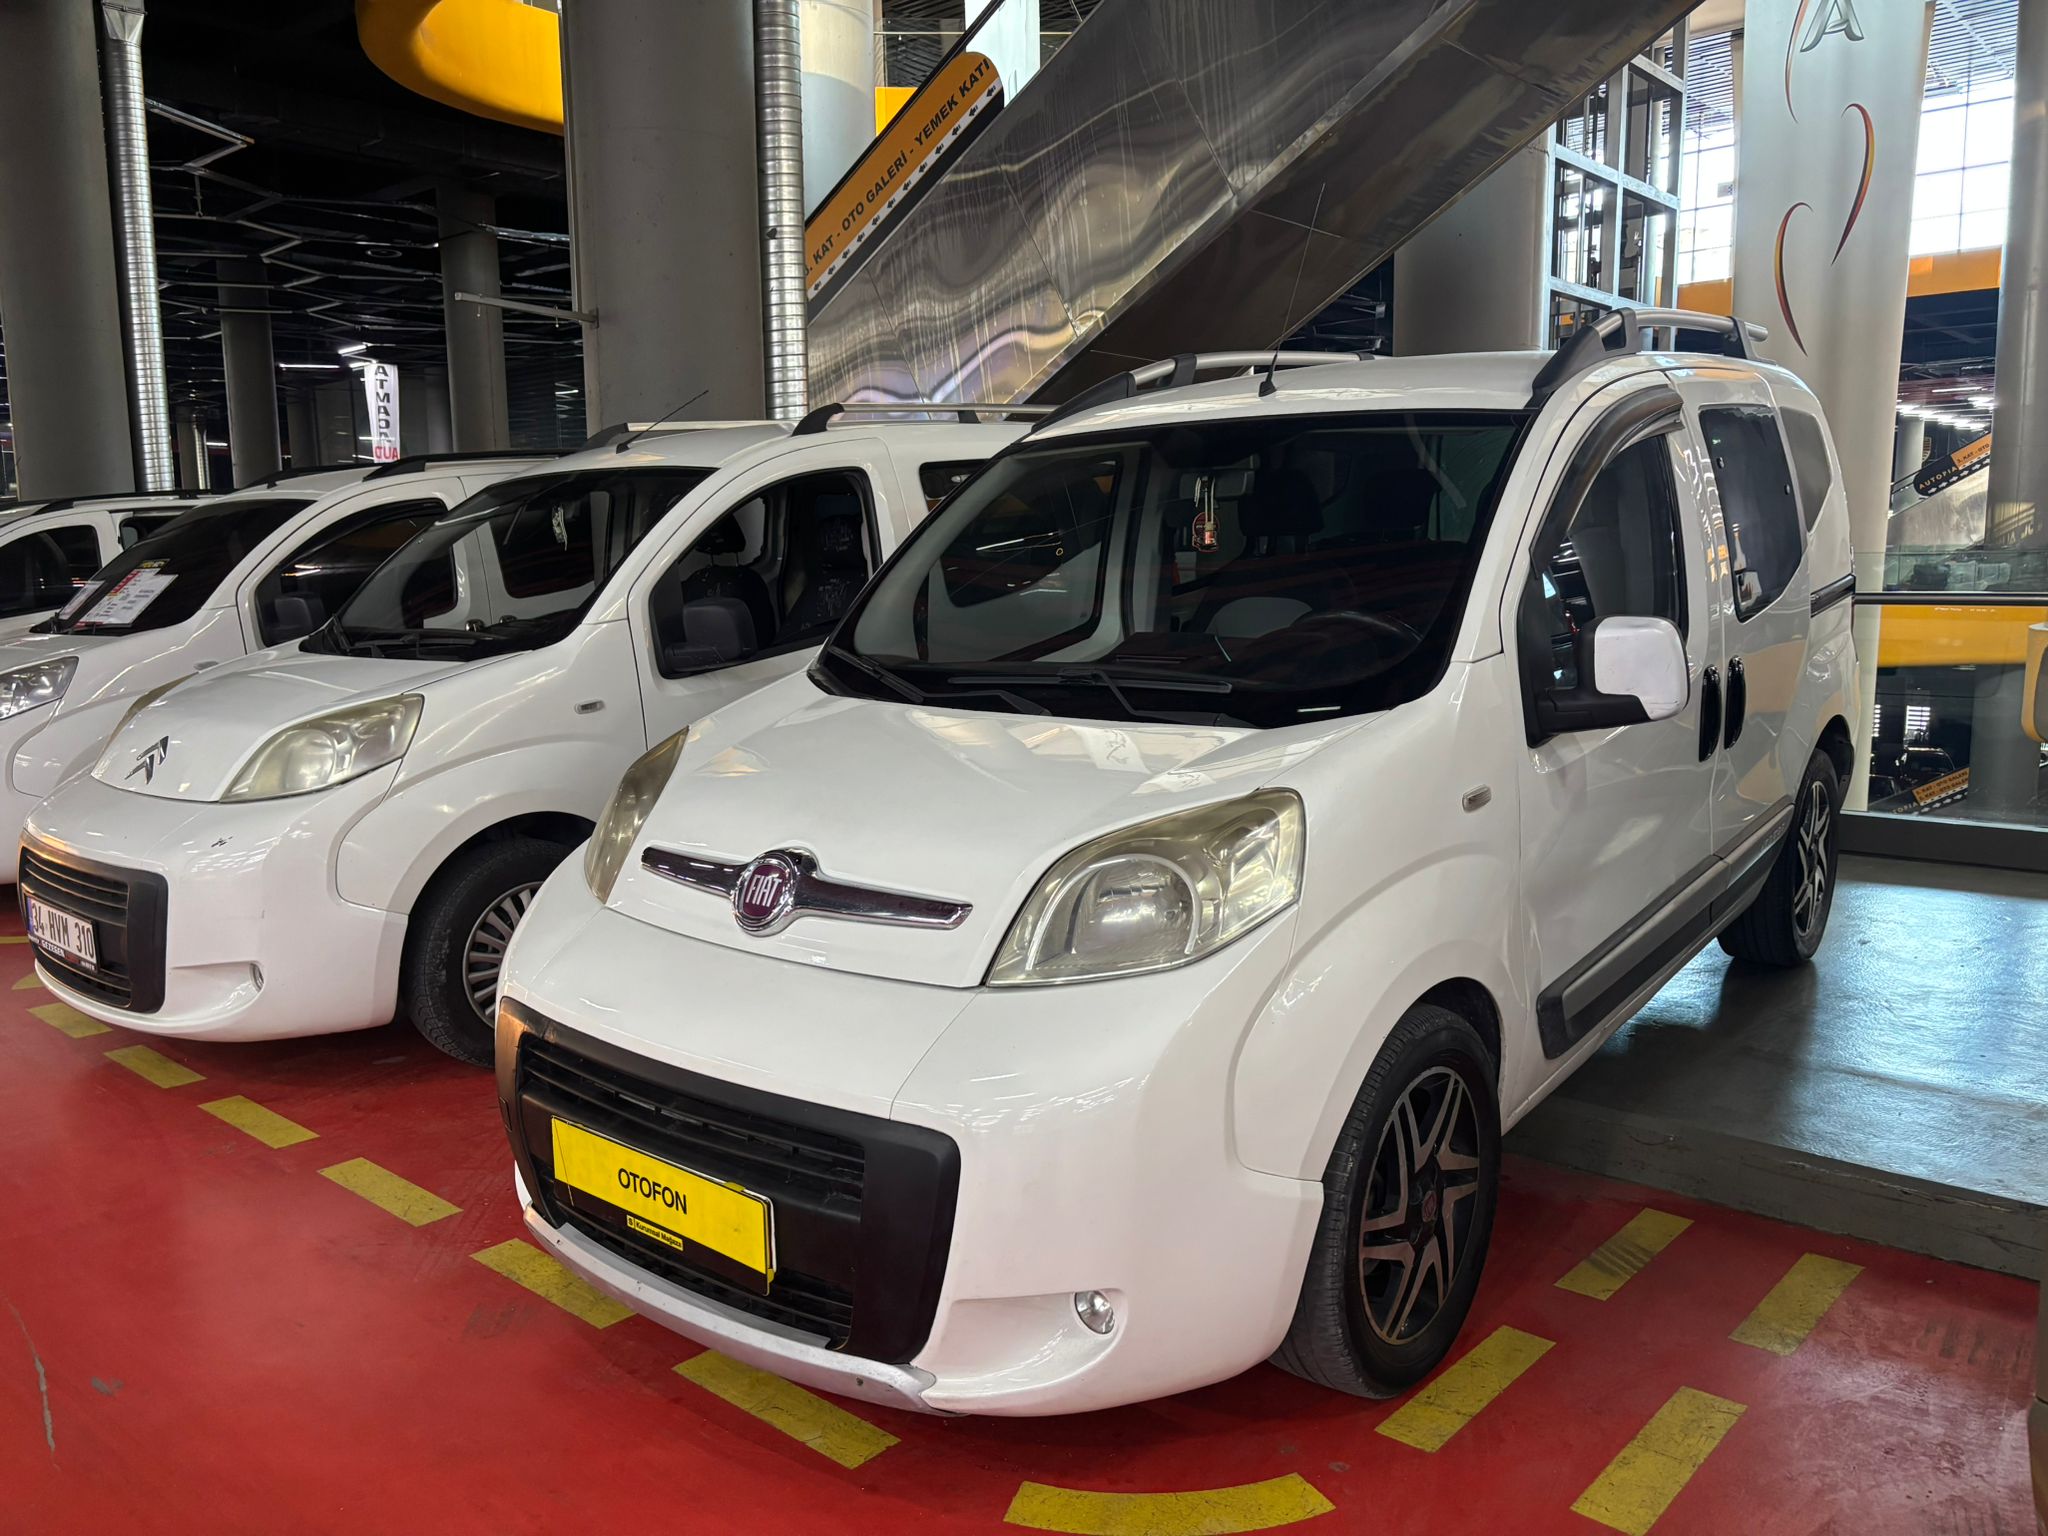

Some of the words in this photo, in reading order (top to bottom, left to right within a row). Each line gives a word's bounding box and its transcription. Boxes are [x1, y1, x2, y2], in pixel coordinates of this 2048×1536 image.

[812, 234, 835, 265] KAT
[841, 202, 865, 232] OTO
[866, 149, 909, 203] GALERİ
[914, 94, 959, 146] YEMEK
[958, 58, 990, 98] KATI
[1919, 465, 1958, 490] AUTOPIA
[745, 874, 783, 908] FIAT
[32, 903, 45, 936] 34
[47, 910, 70, 948] HVM
[74, 921, 95, 959] 310
[617, 1167, 687, 1215] OTOFON
[635, 1221, 661, 1239] Kurumsal
